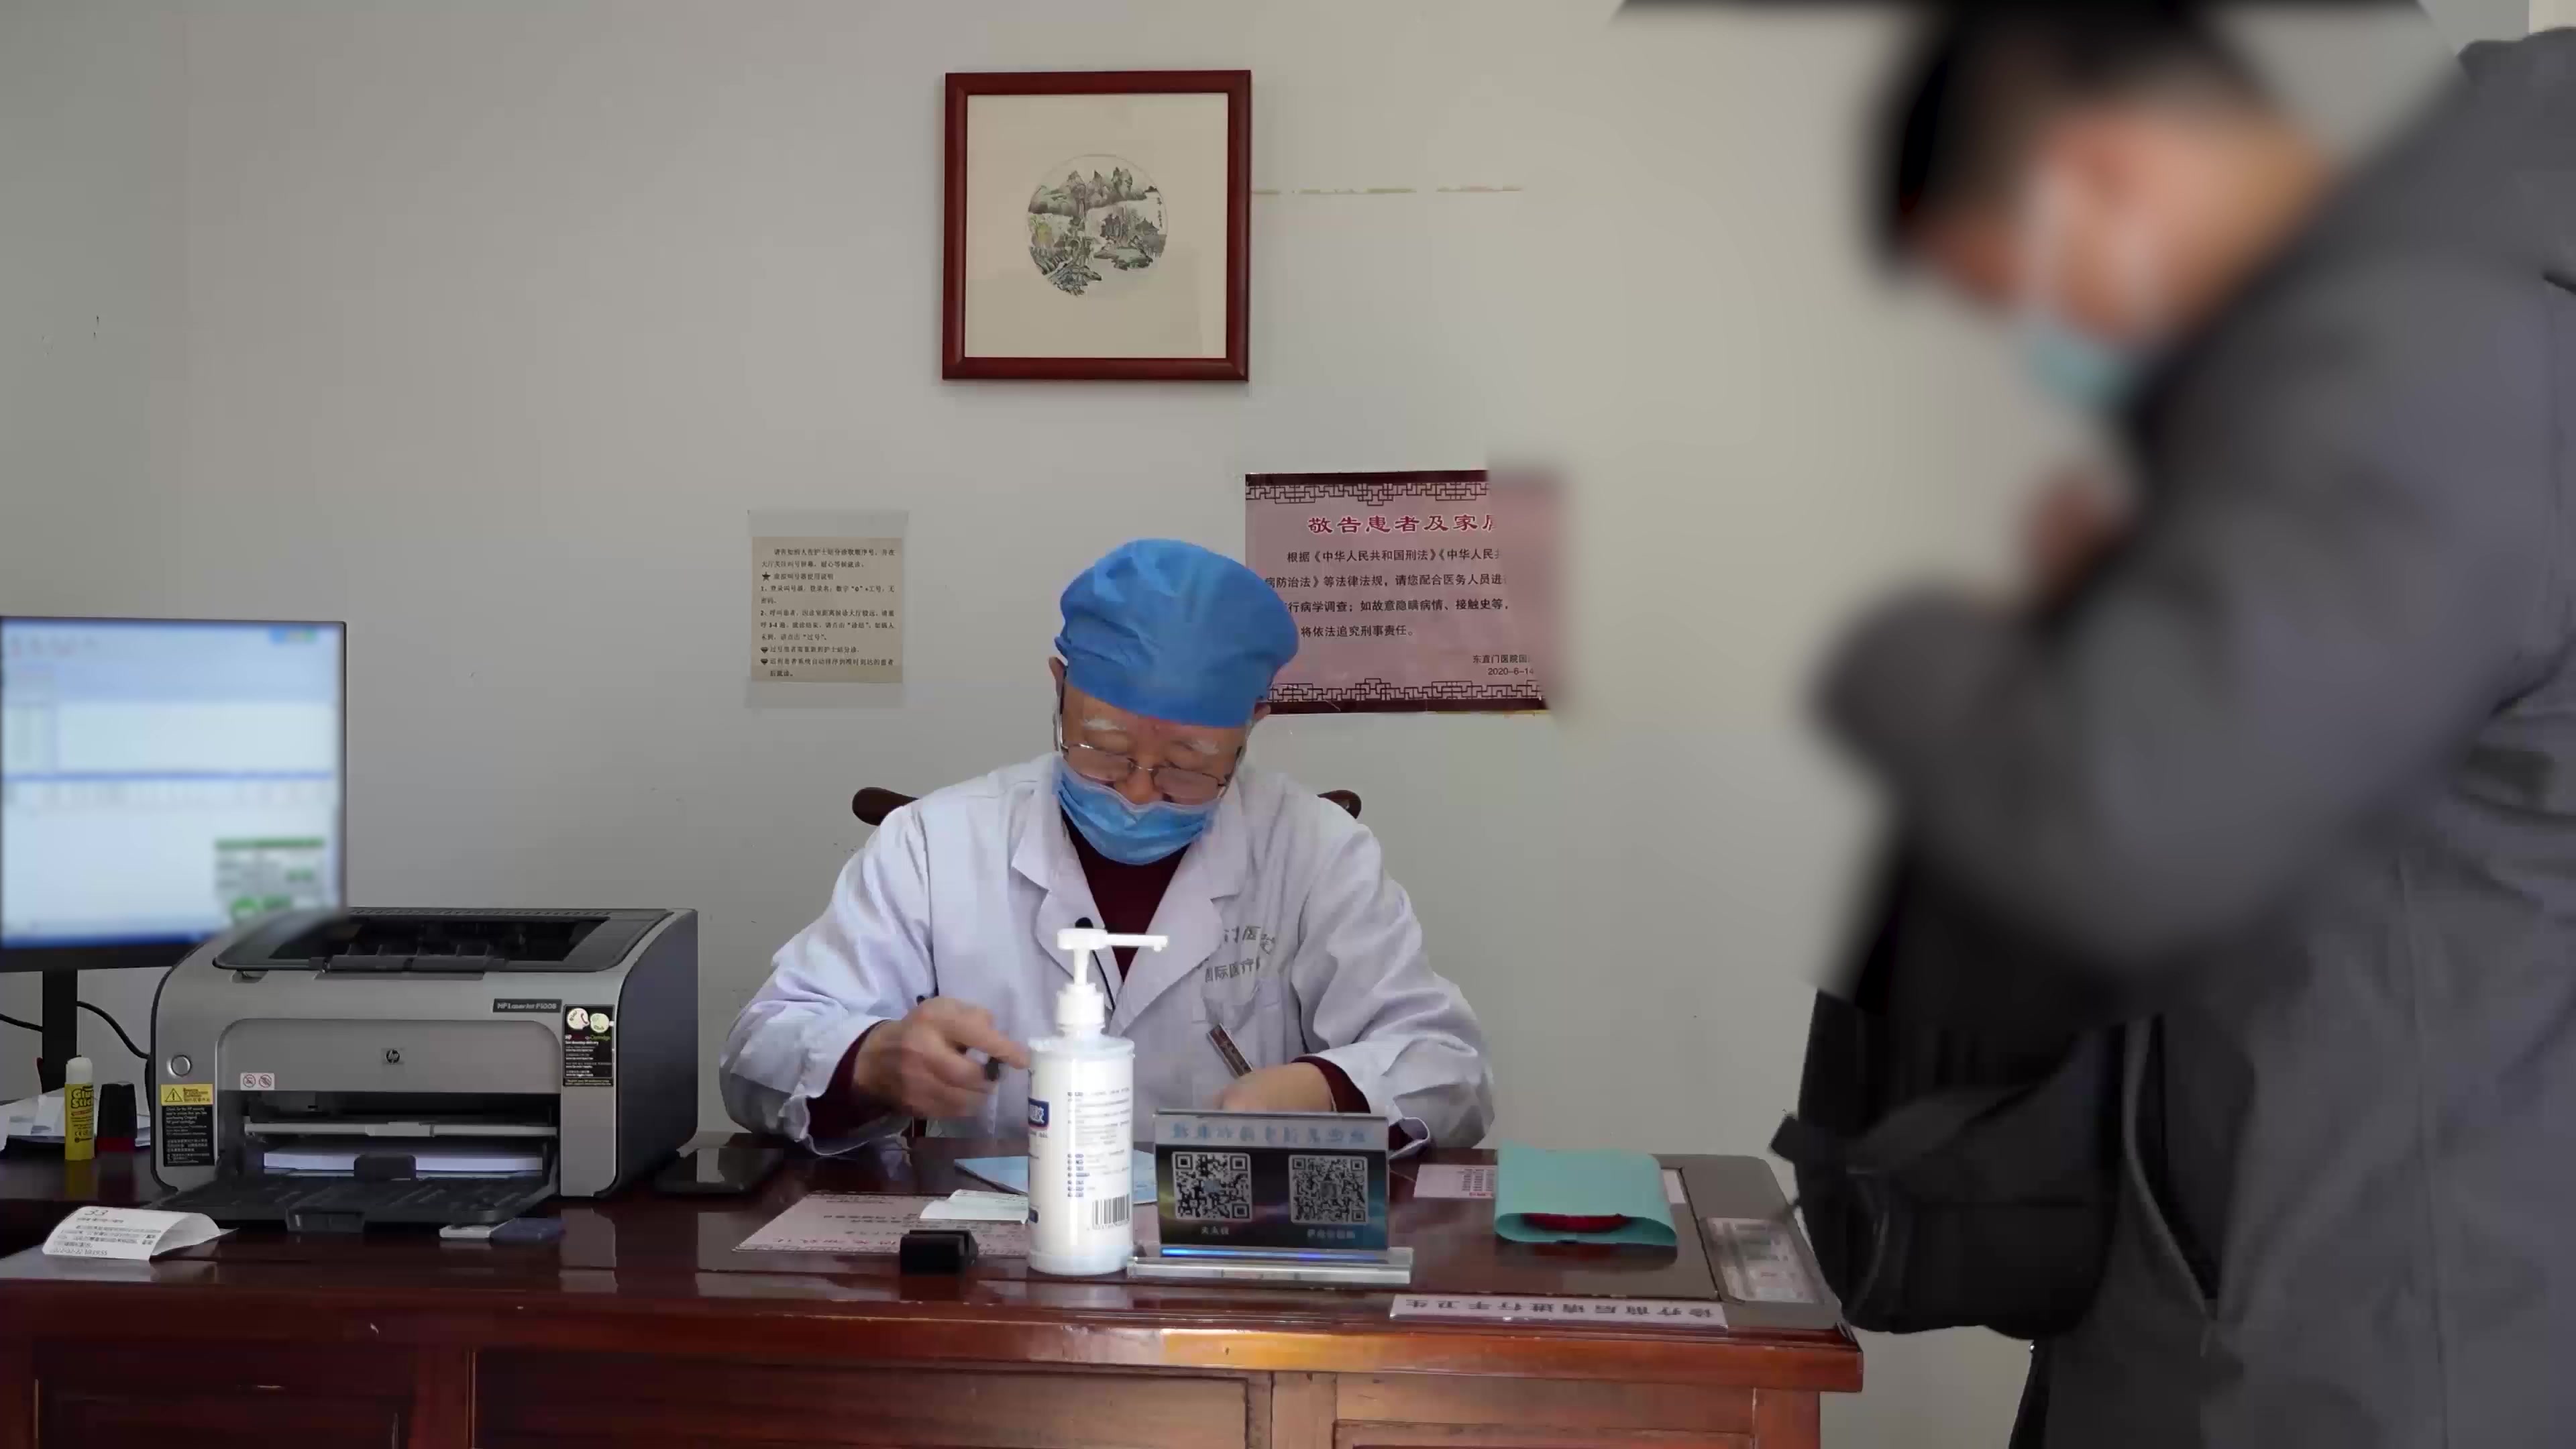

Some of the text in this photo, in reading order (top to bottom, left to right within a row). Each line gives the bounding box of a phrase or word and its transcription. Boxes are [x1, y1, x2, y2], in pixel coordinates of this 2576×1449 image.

[1265, 574, 1507, 588] 病防治法》等法律法规，请您配合医务人员进
[1285, 598, 1508, 613] 行病学调查；如故意隐瞒病情、接触史等，
[1301, 624, 1414, 638] 将依法追究刑事责任。
[1472, 654, 1531, 663] 东直门医院国
[1205, 955, 1260, 983] 国际医疗
